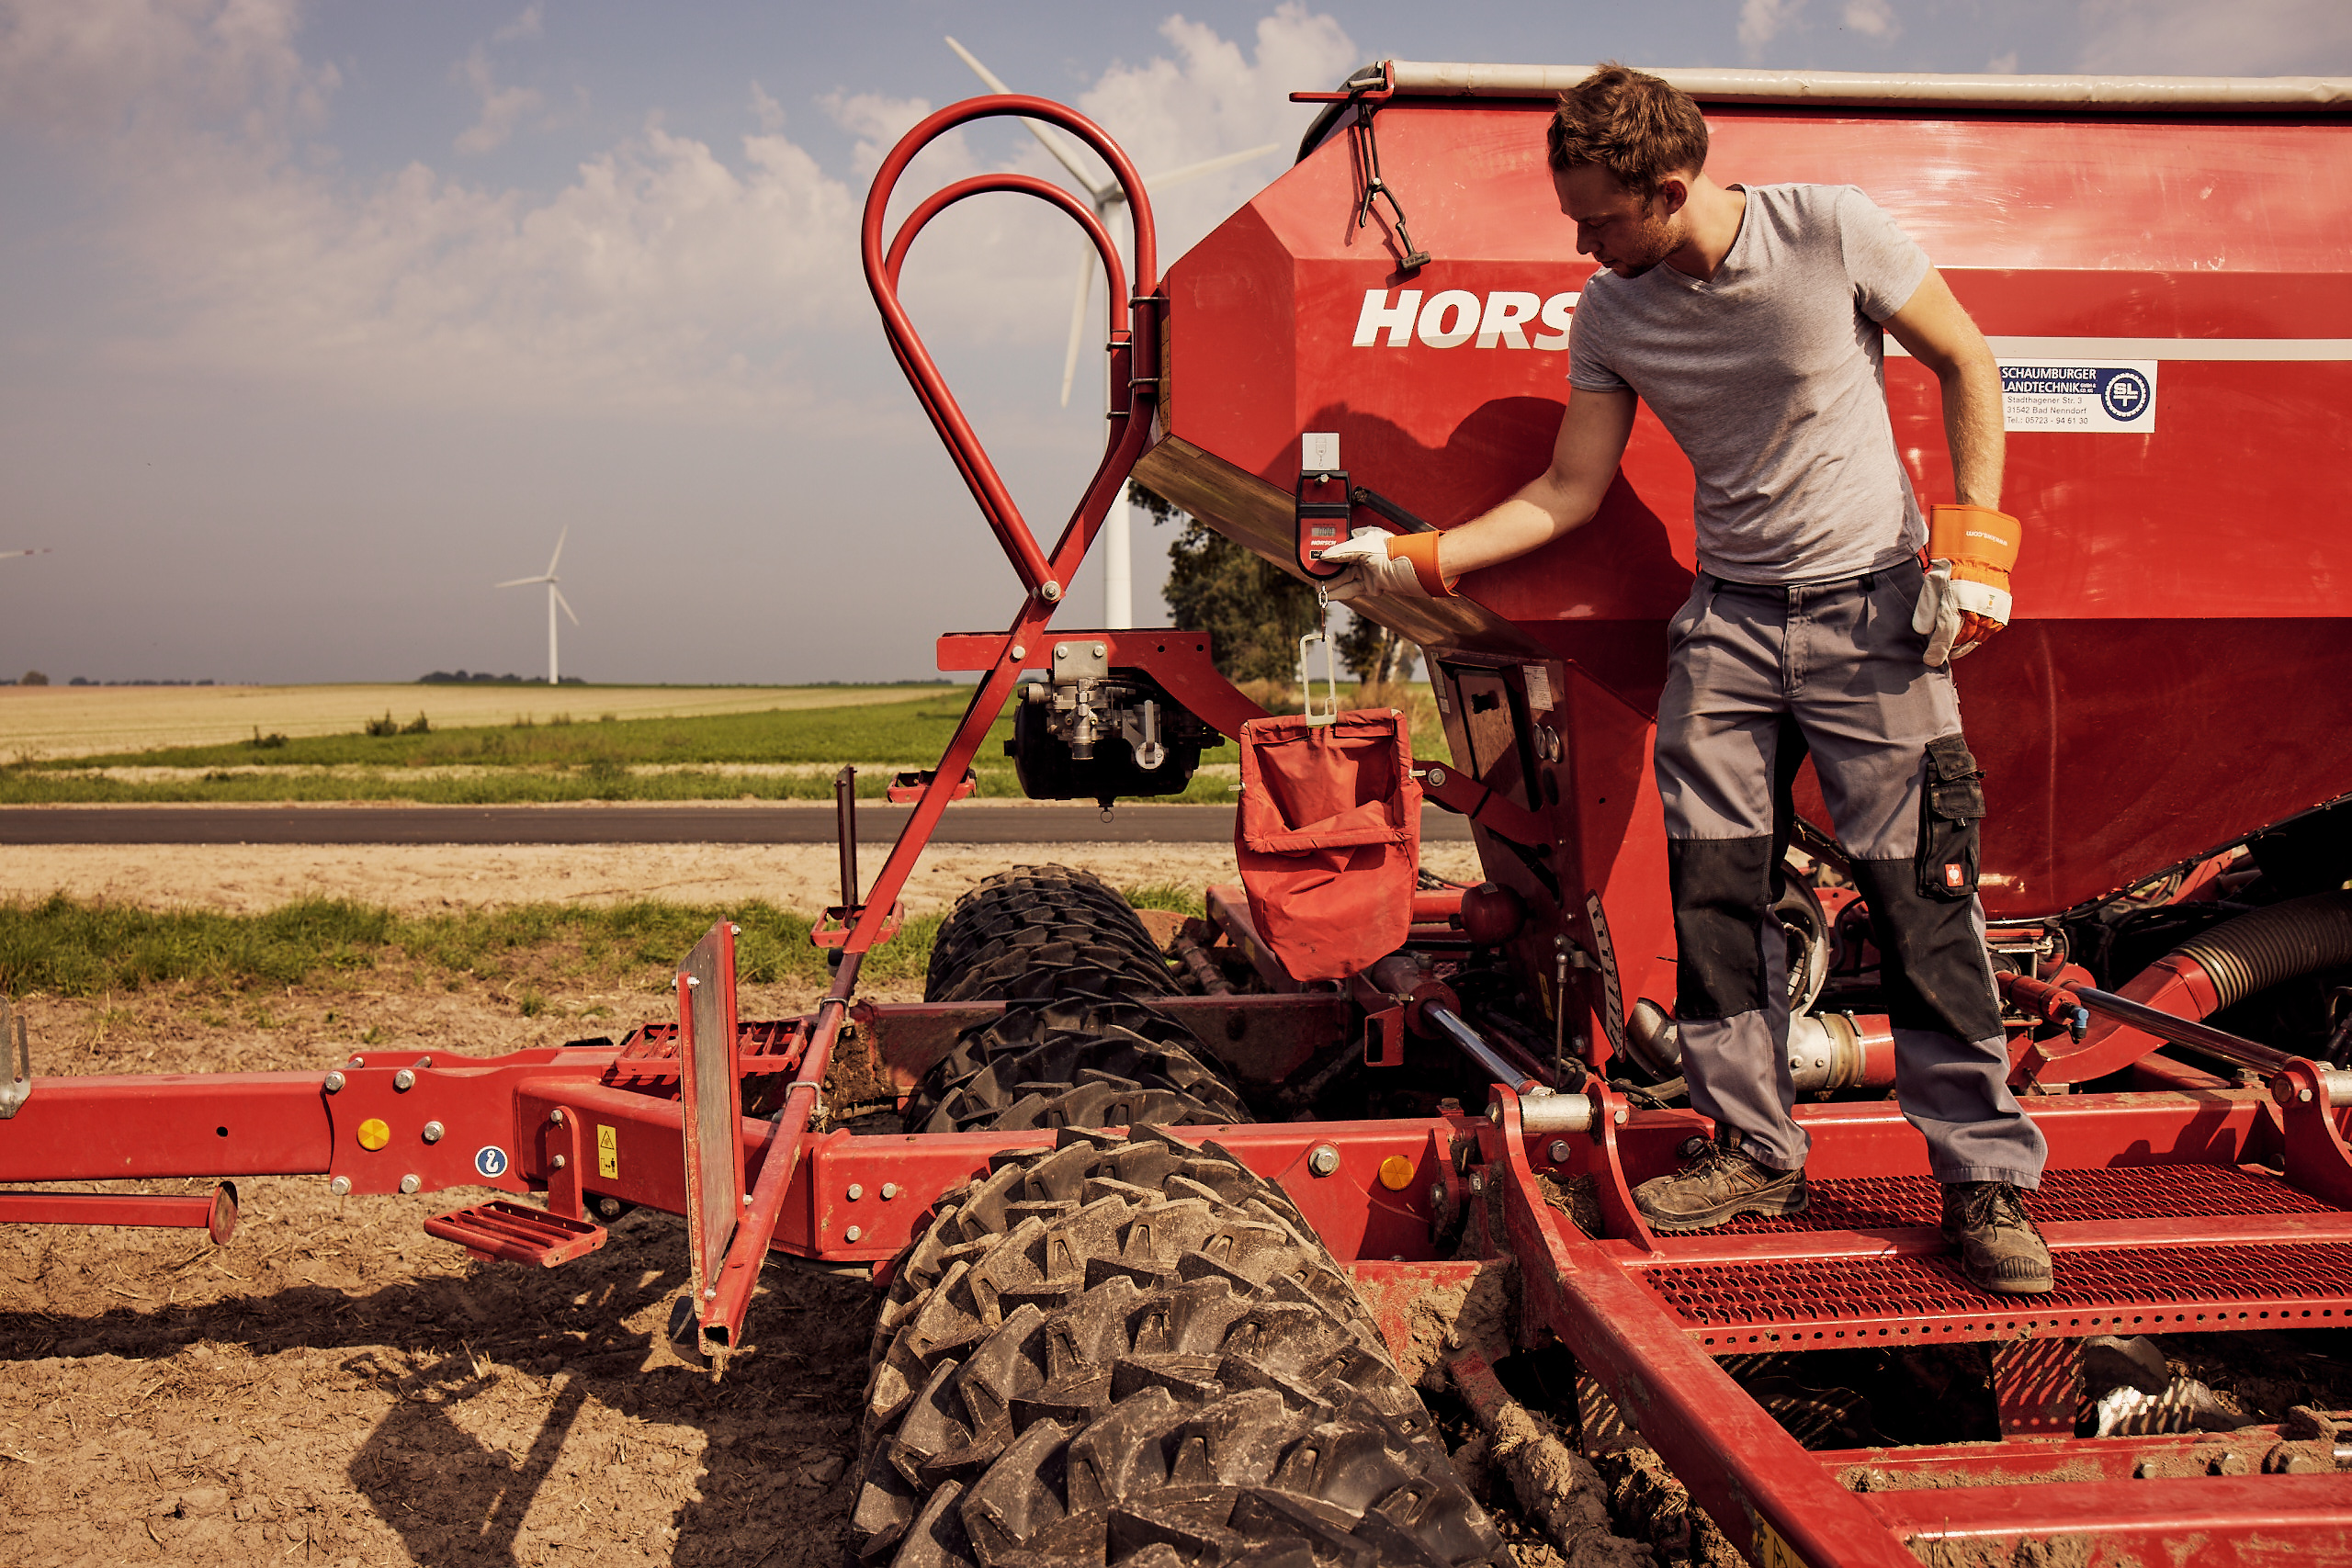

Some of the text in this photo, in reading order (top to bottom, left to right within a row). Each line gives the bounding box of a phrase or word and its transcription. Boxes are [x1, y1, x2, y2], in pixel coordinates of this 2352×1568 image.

[1351, 288, 1581, 351] HORS
[2001, 367, 2097, 380] SCHAUMBURGER
[2001, 381, 2080, 393] LANDTECHNIK
[2007, 396, 2059, 405] Stadthagener
[2062, 396, 2075, 404] Str.
[2007, 406, 2030, 414] 31542
